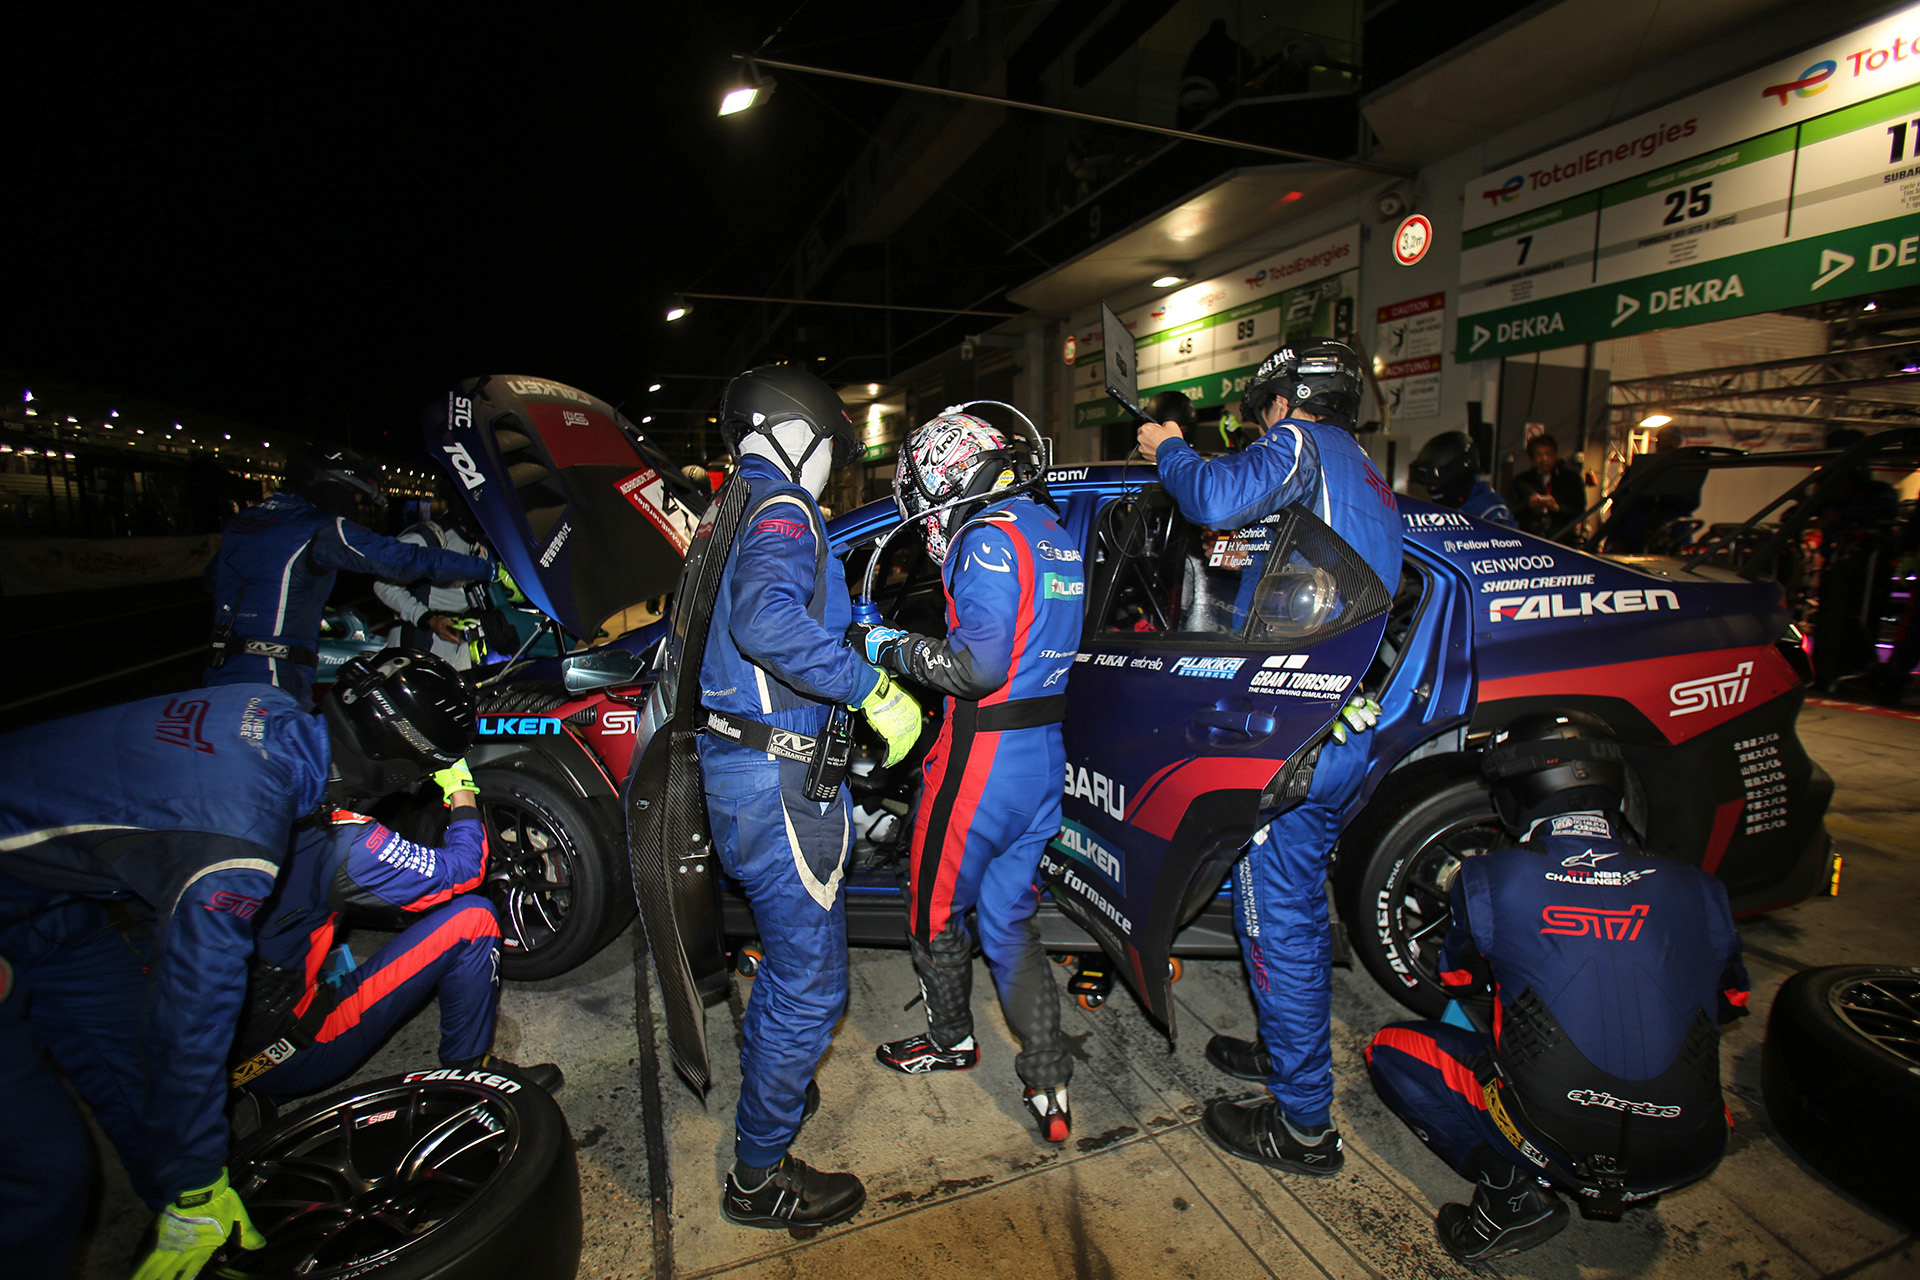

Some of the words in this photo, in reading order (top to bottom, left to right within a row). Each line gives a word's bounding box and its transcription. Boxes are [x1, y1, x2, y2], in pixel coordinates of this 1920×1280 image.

[1529, 118, 1698, 191] TotalEnergies
[1663, 181, 1714, 226] 25
[1268, 243, 1351, 281] TotalEnergies
[1517, 235, 1534, 266] 7
[1649, 274, 1745, 314] DEKRA
[1391, 299, 1430, 317] CAUTION
[1237, 319, 1255, 341] 89
[1497, 312, 1565, 342] DEKRA
[1385, 360, 1431, 377] ACHTUNG
[506, 380, 592, 406] FALKEN
[455, 396, 472, 428] STC
[934, 428, 958, 458] Arai
[442, 442, 486, 490] TOA
[633, 493, 683, 549] TotalEnergies
[754, 518, 807, 538] STI
[1227, 540, 1271, 552] H.Yamauchi
[1456, 540, 1489, 550] Fellow
[1490, 538, 1522, 549] Room
[1224, 555, 1254, 568] T.Iguchi
[1471, 555, 1555, 575] KENWOOD
[1481, 577, 1530, 593] SHODA
[1530, 574, 1595, 590] CREATIVE
[1484, 589, 1680, 623] FALKEN
[1094, 654, 1129, 667] FUKAI
[1169, 657, 1246, 674] FUJIKIKAI
[1248, 686, 1260, 694] THE
[1259, 687, 1275, 695] REAL
[1276, 688, 1300, 697] DRIVING
[1301, 690, 1342, 700] SIMULATOR
[1250, 670, 1291, 687] GRAN
[1286, 672, 1353, 693] TURISMO
[1669, 661, 1754, 718] STI
[156, 698, 215, 755] STI
[769, 744, 808, 762] MECHANIX
[1060, 823, 1122, 884] ALKEN
[1545, 872, 1621, 886] CHALLENGE
[1593, 871, 1621, 880] NBR
[1039, 854, 1132, 936] Peformance
[1540, 905, 1650, 941] STI
[1376, 890, 1418, 988] FALKEN
[270, 1041, 290, 1063] 30
[403, 1070, 522, 1094] FALKEN
[1567, 1089, 1681, 1118] alpinestars
[367, 1110, 397, 1125] BBS
